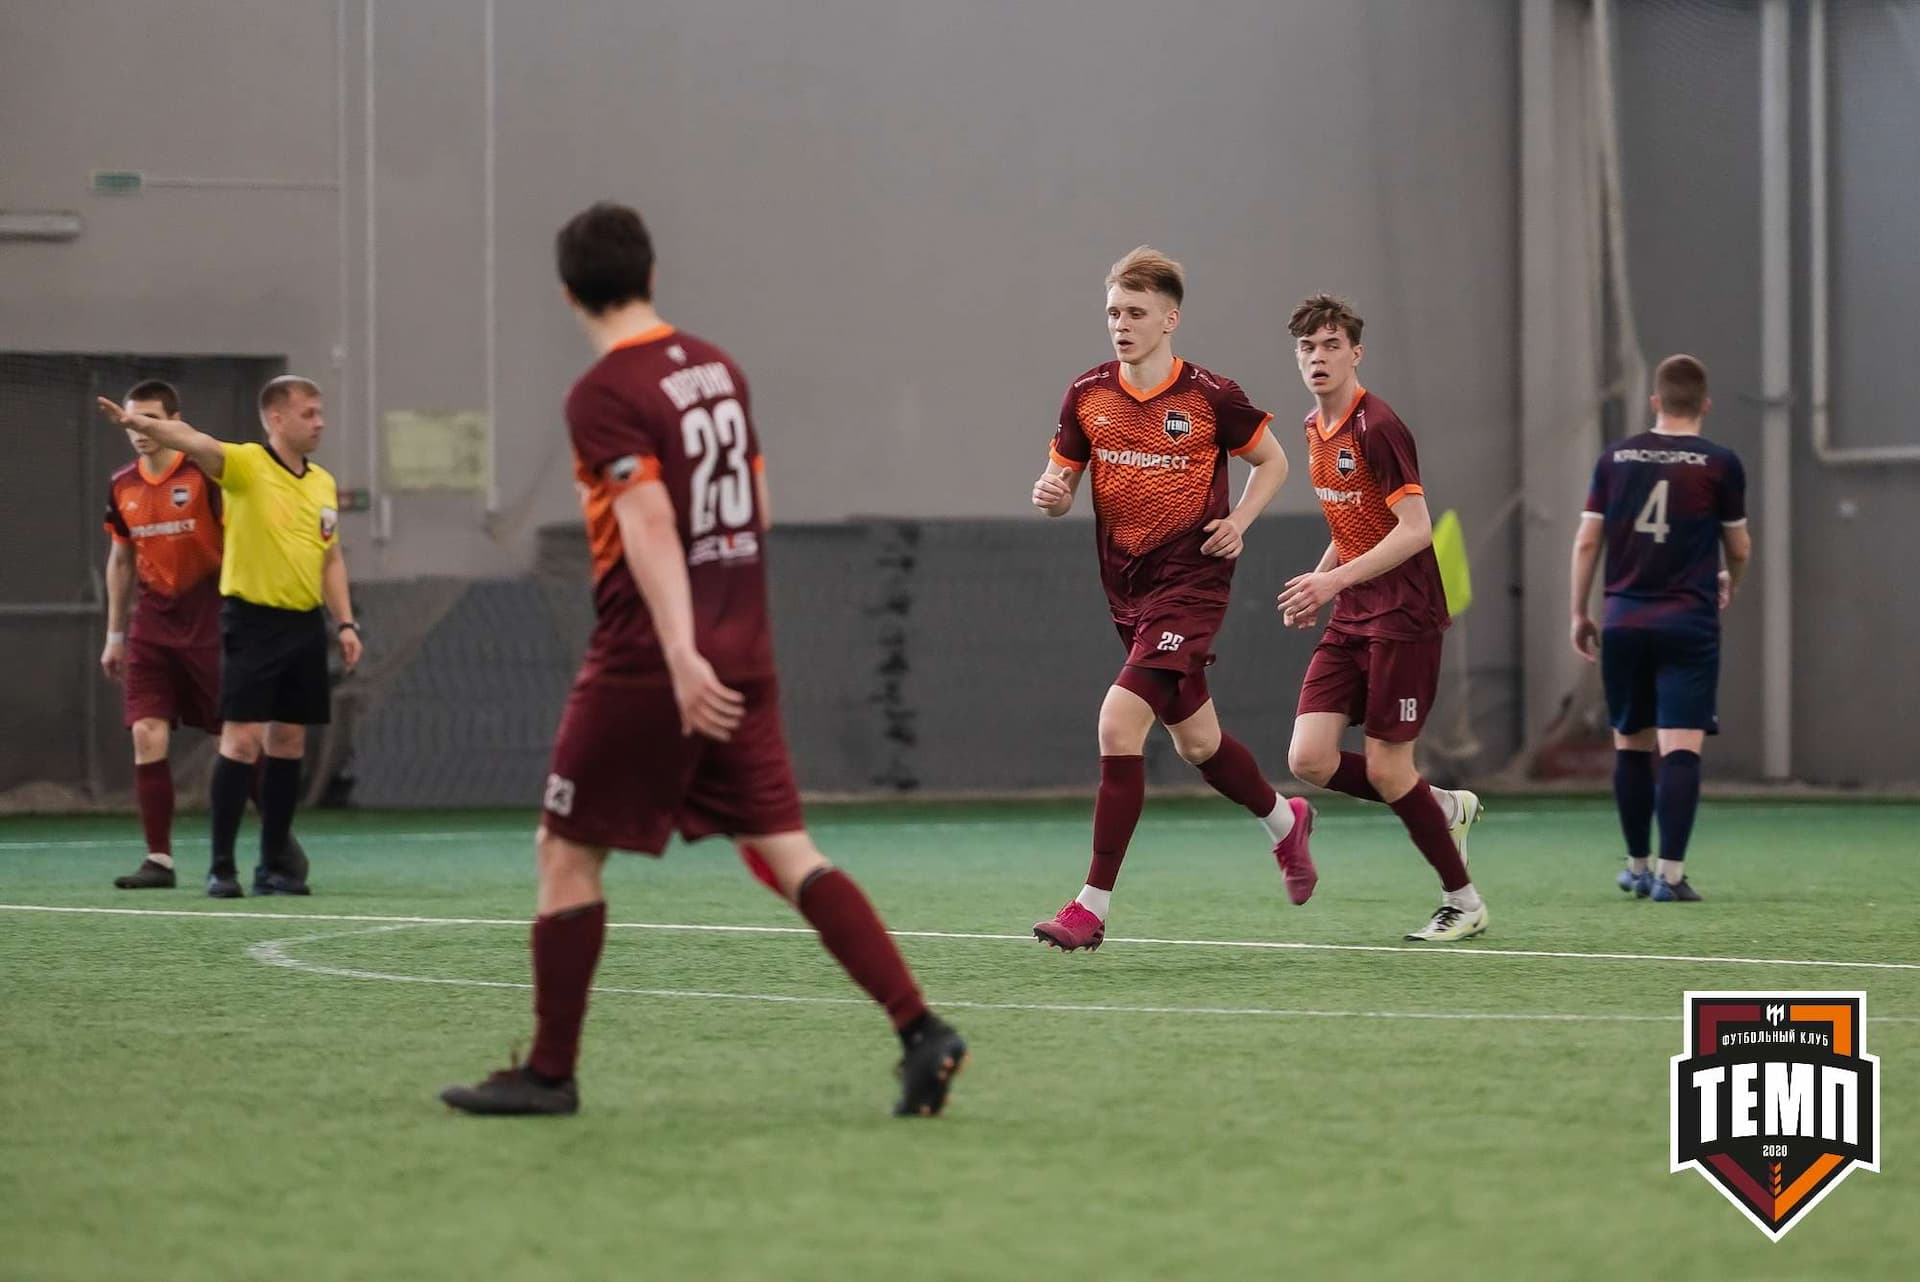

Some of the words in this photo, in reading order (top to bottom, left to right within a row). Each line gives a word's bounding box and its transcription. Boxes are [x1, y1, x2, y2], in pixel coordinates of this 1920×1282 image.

[1166, 419, 1189, 433] ТЕМП
[682, 398, 753, 537] 23
[1634, 479, 1671, 544] 4
[1398, 697, 1418, 722] 18
